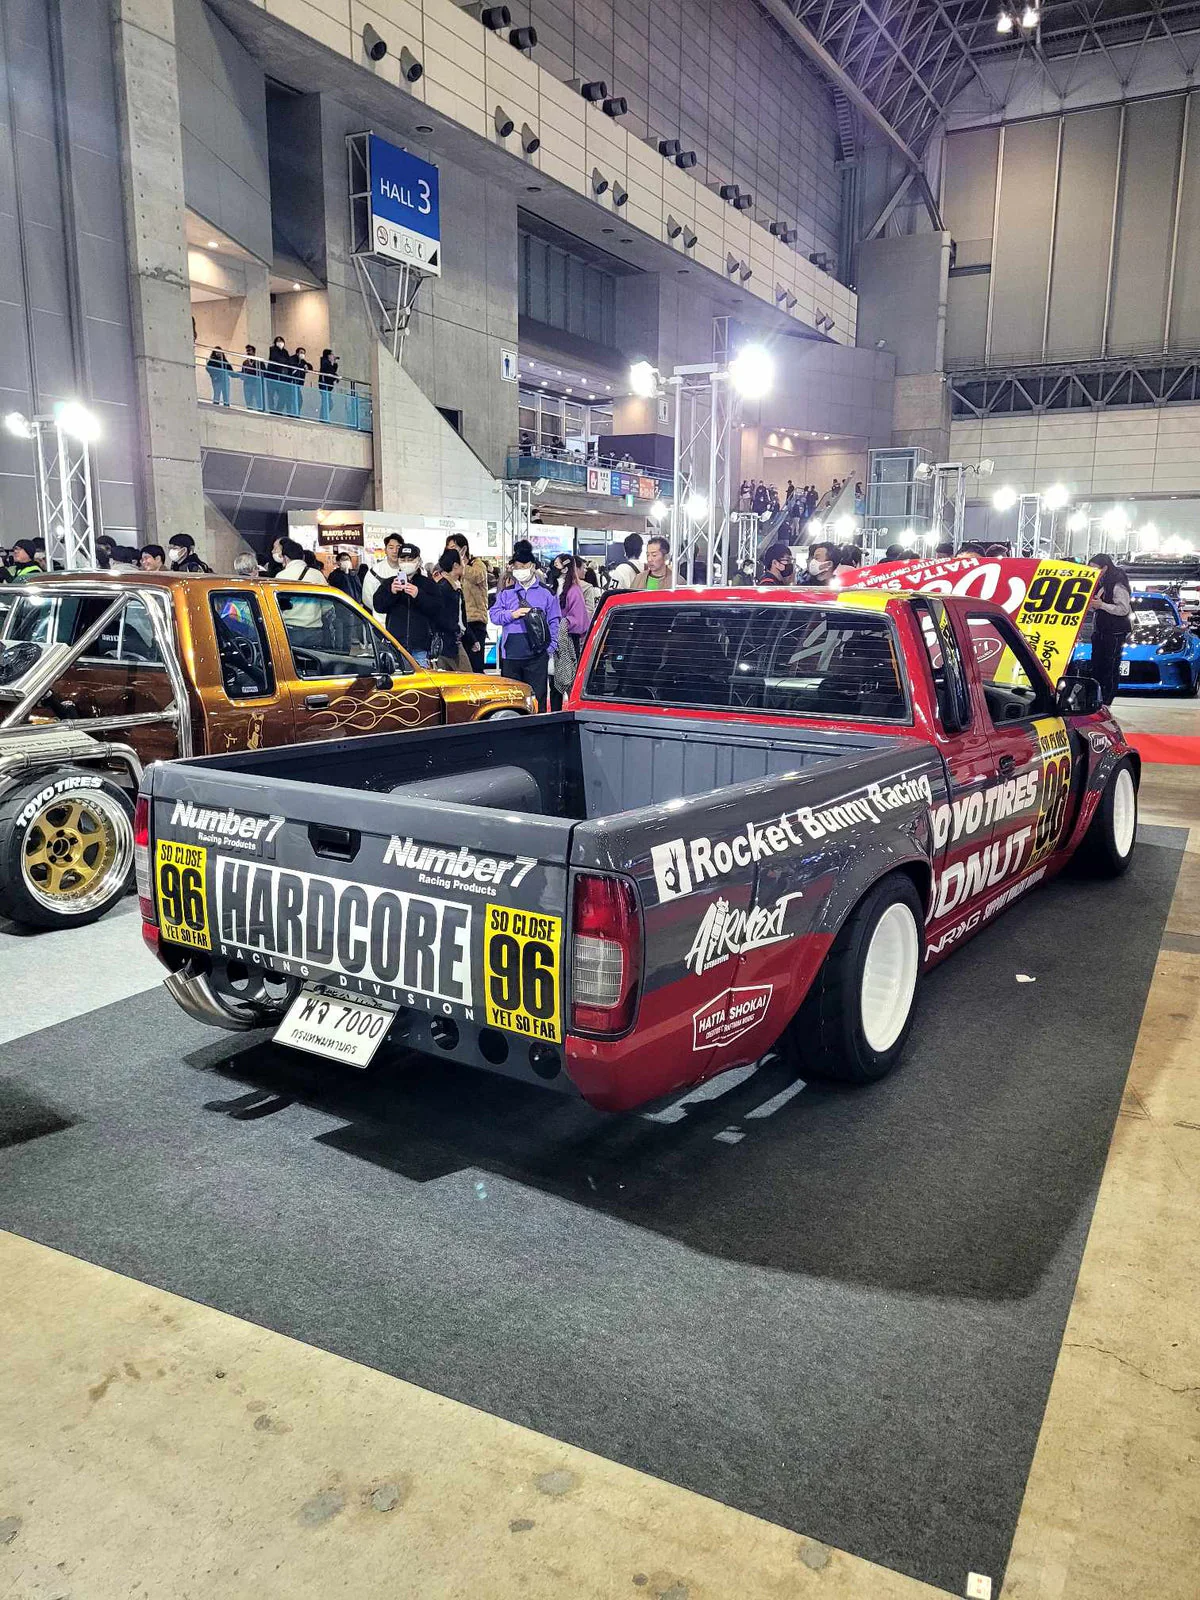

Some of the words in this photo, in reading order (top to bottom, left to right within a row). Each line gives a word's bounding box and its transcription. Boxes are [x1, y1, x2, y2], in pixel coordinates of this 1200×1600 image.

[380, 177, 415, 209] HALL
[417, 179, 431, 215] 3
[905, 557, 980, 584] HATTA
[1037, 568, 1058, 577] FAR
[1077, 570, 1096, 579] YET
[1023, 576, 1094, 615] 96
[1018, 612, 1060, 625] CLOSE
[1061, 614, 1080, 627] SO
[101, 633, 127, 643] BRID
[16, 786, 55, 828] TOYO
[54, 776, 103, 793] TIRES
[931, 791, 983, 850] OYO
[984, 770, 1039, 827] TIRES
[198, 832, 223, 846] Racing
[223, 836, 257, 850] Products
[690, 812, 803, 883] Rocket
[797, 806, 881, 839] Bunny
[867, 773, 933, 813] Racing
[160, 844, 172, 862] SO
[174, 847, 203, 868] CLOSE
[418, 873, 451, 890] Racing
[452, 880, 498, 897] Products
[924, 825, 1033, 926] ONUT
[161, 863, 206, 931] 96
[165, 923, 180, 940] YET
[181, 929, 191, 943] SO
[192, 930, 208, 947] FAR
[219, 860, 470, 1001] HARDCORE
[490, 909, 509, 933] SO
[512, 913, 556, 943] CLOSE
[220, 944, 310, 977] RACING
[339, 975, 475, 1021] DIVISION
[489, 933, 555, 1020] 96
[334, 1006, 384, 1039] 7000
[491, 1008, 512, 1028] YET
[515, 1014, 530, 1032] SO
[533, 1018, 556, 1040] FAR
[698, 1009, 726, 1033] HATTA
[729, 994, 767, 1020] SHOKAI
